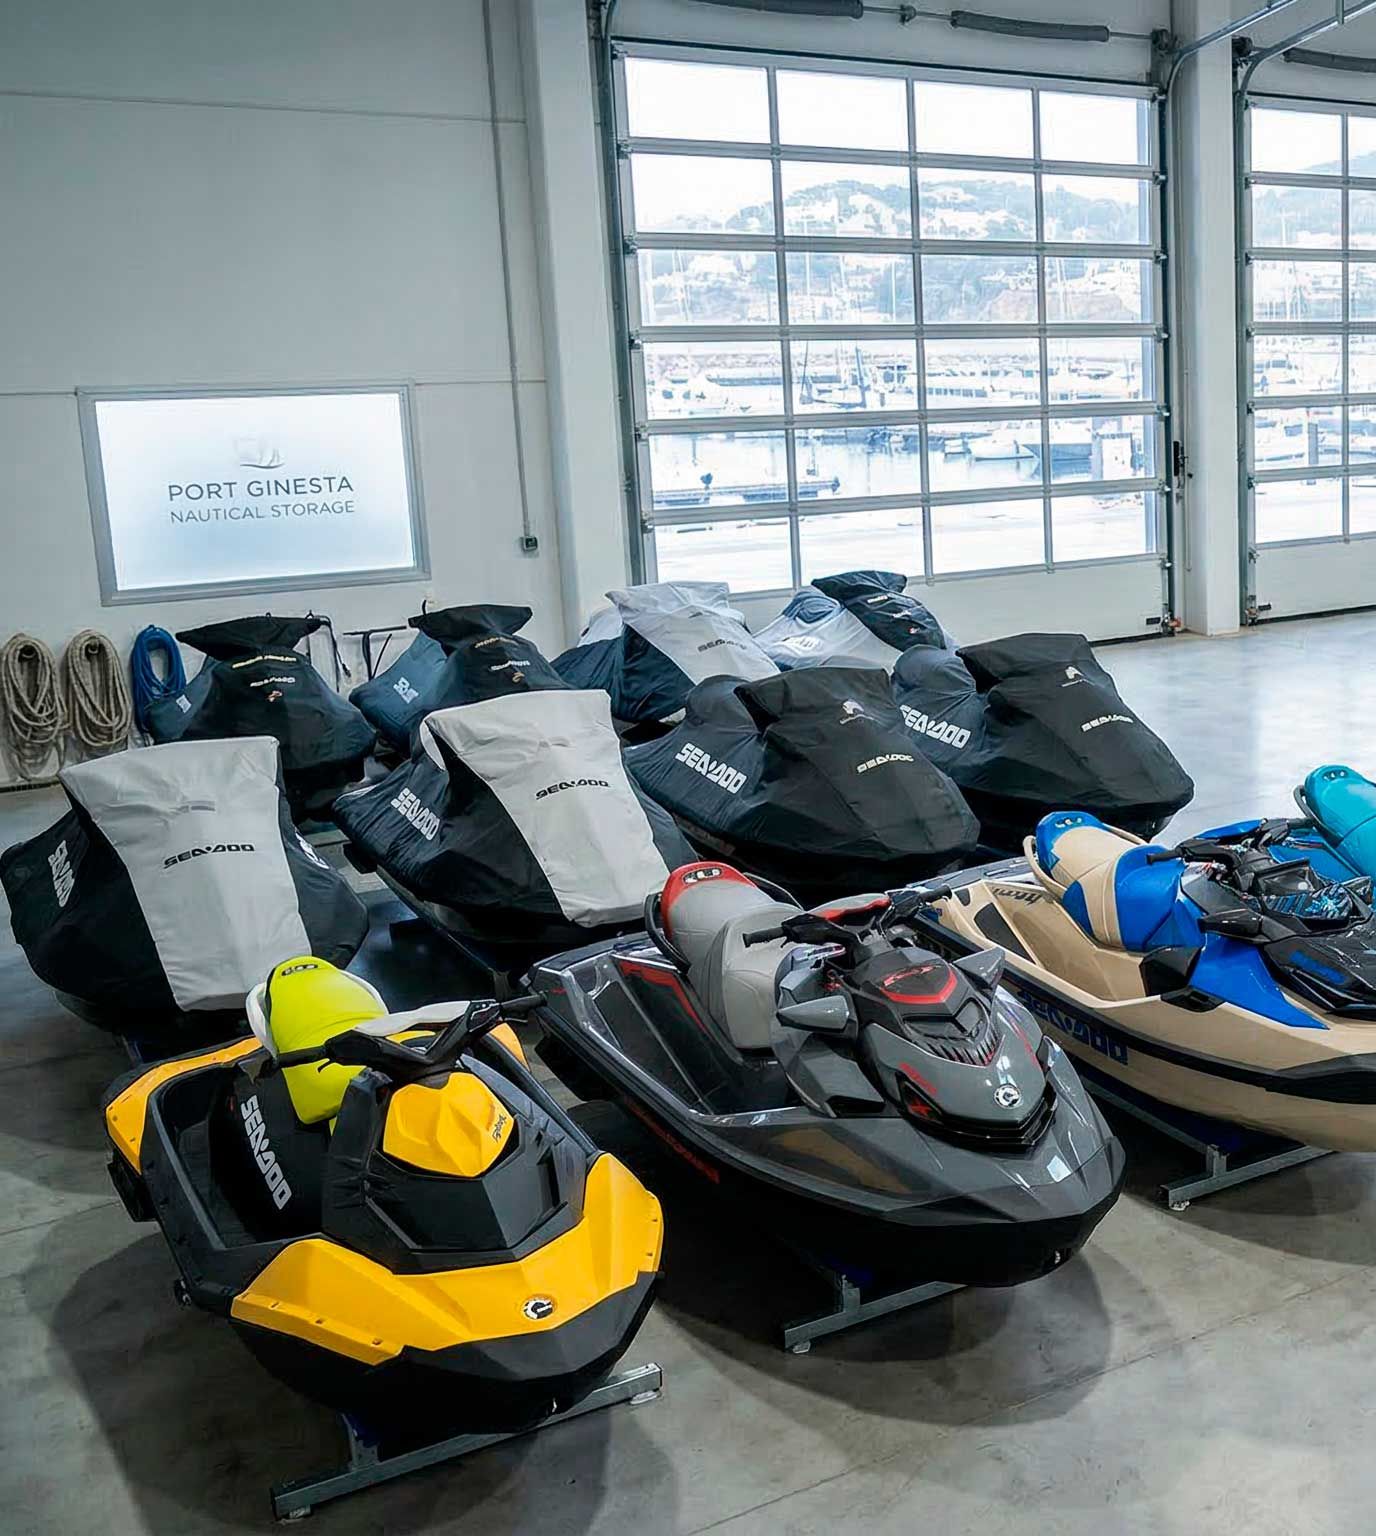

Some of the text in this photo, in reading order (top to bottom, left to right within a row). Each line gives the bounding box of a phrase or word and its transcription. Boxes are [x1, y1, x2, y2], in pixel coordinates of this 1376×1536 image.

[168, 476, 354, 501] PORT GINESTA
[170, 500, 355, 524] NAUTICAL STORAGE
